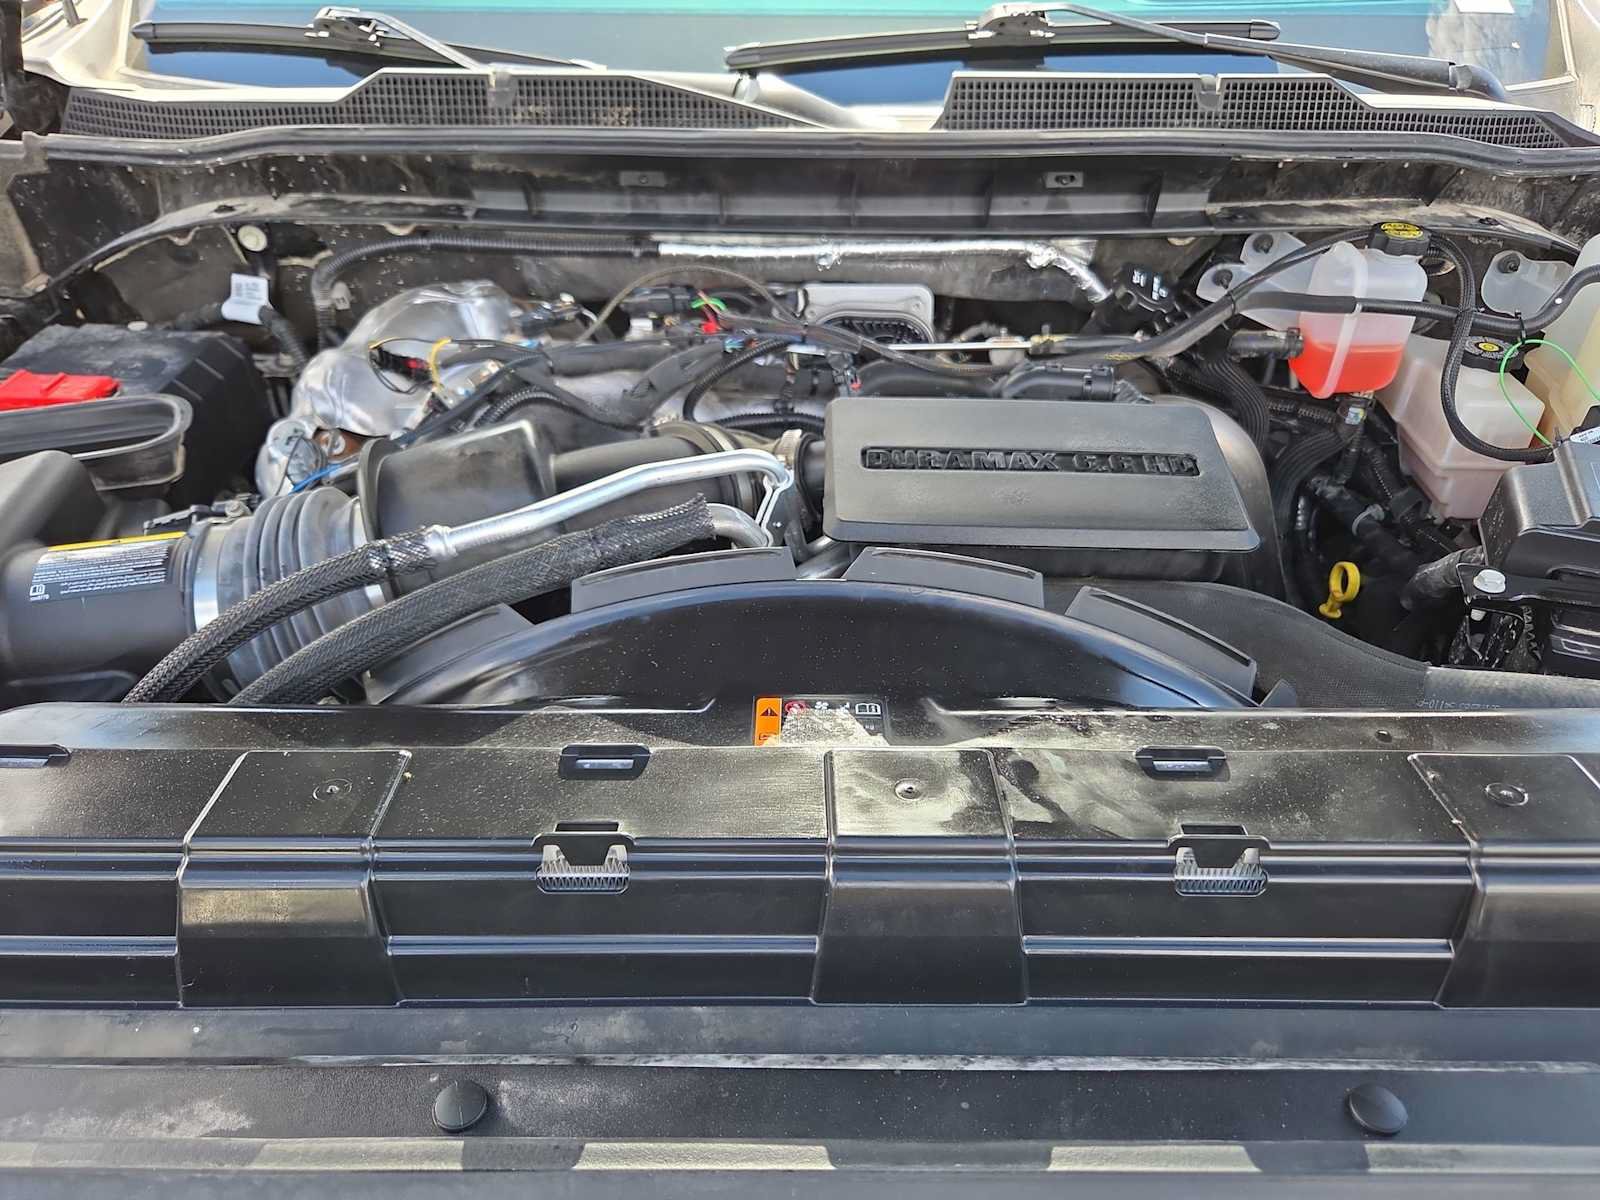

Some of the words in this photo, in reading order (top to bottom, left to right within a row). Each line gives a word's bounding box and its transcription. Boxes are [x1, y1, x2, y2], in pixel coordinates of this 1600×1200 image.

[865, 449, 1060, 471] DURAMAX
[1071, 453, 1138, 473] 6.6
[1142, 455, 1198, 475] HD
